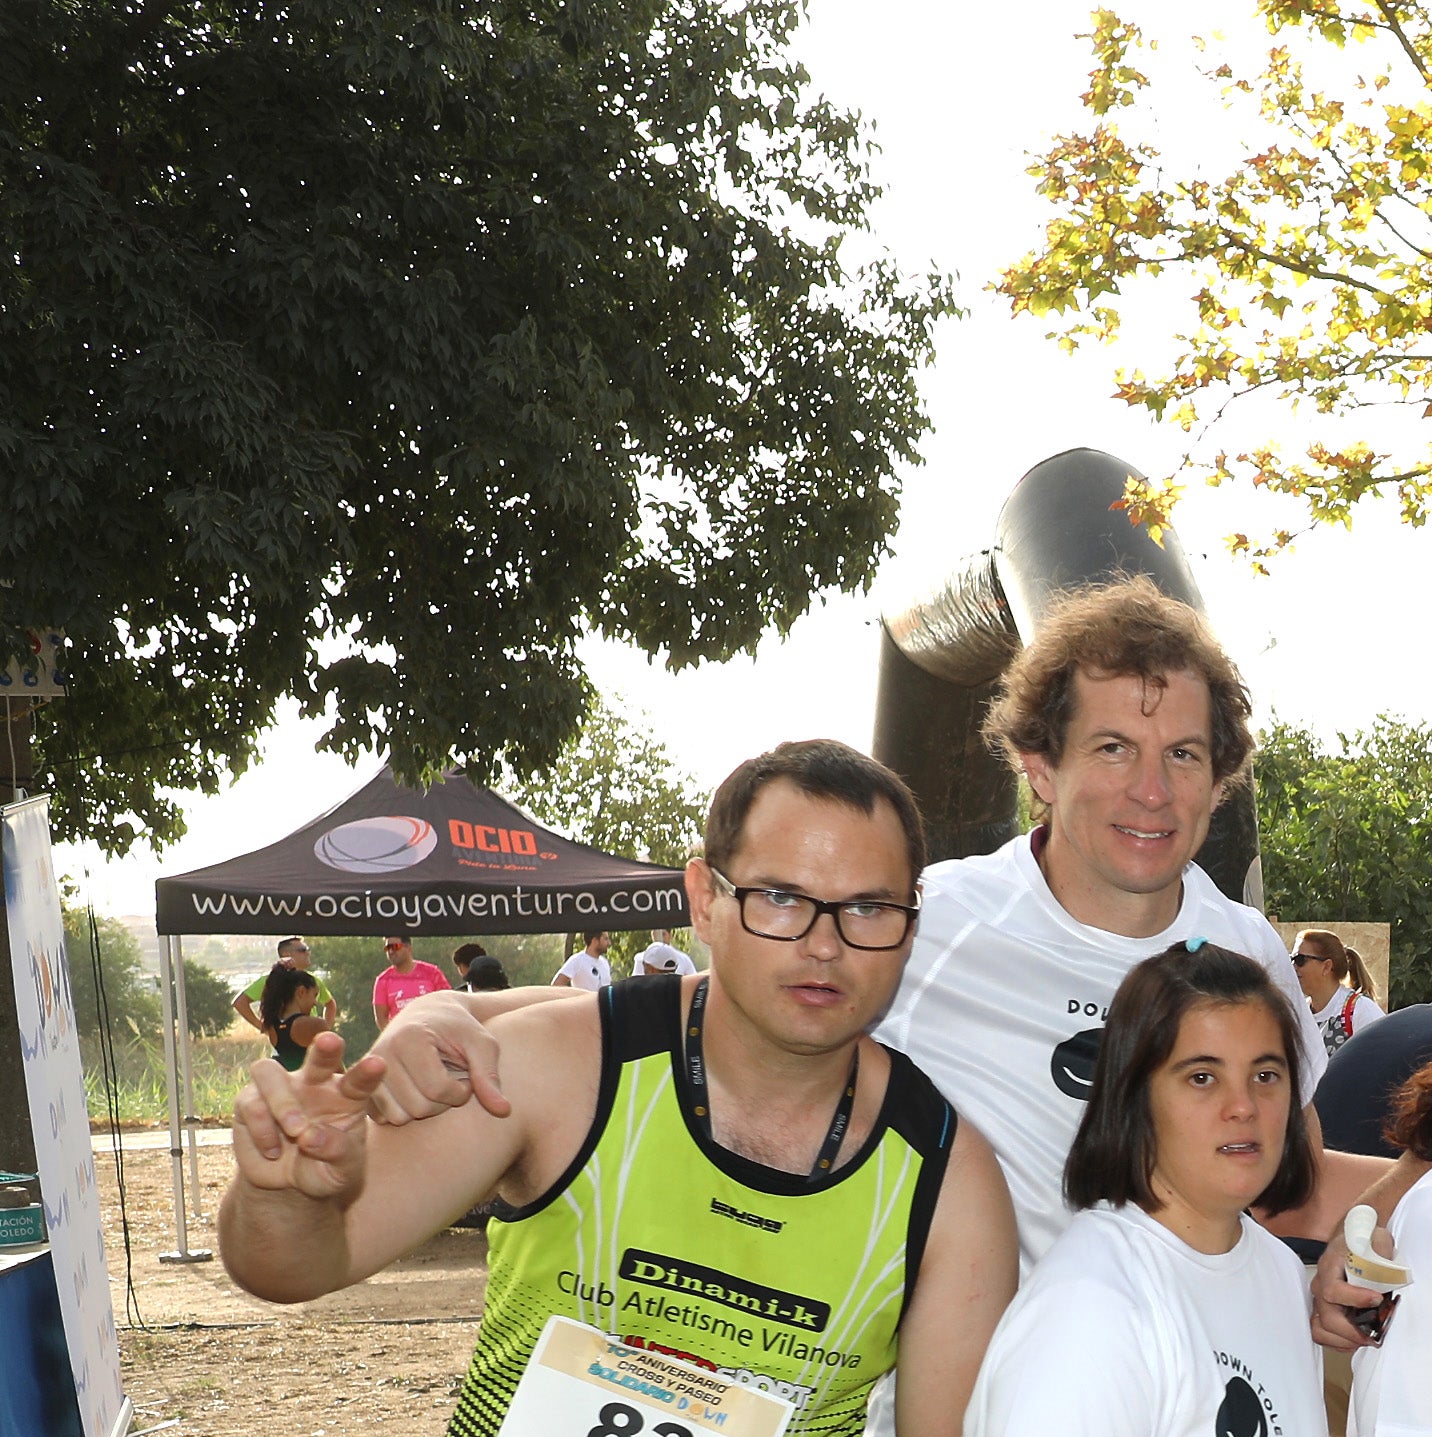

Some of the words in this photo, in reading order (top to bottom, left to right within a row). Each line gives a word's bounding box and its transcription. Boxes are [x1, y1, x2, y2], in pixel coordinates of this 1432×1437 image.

[448, 818, 537, 856] OCIO
[191, 884, 683, 928] www.ocioyaventura.com
[692, 1055, 703, 1085] SMILE
[632, 1259, 818, 1327] Dinami-k
[557, 1271, 614, 1306] Club
[622, 1291, 753, 1347] Atletisme
[762, 1328, 862, 1370] Vilanova
[587, 1362, 677, 1404] SOLIDARIO
[617, 1360, 669, 1386] CROSS
[666, 1380, 677, 1390] Y
[678, 1383, 723, 1406] PASEO
[636, 1354, 729, 1395] ANIVERSARIO
